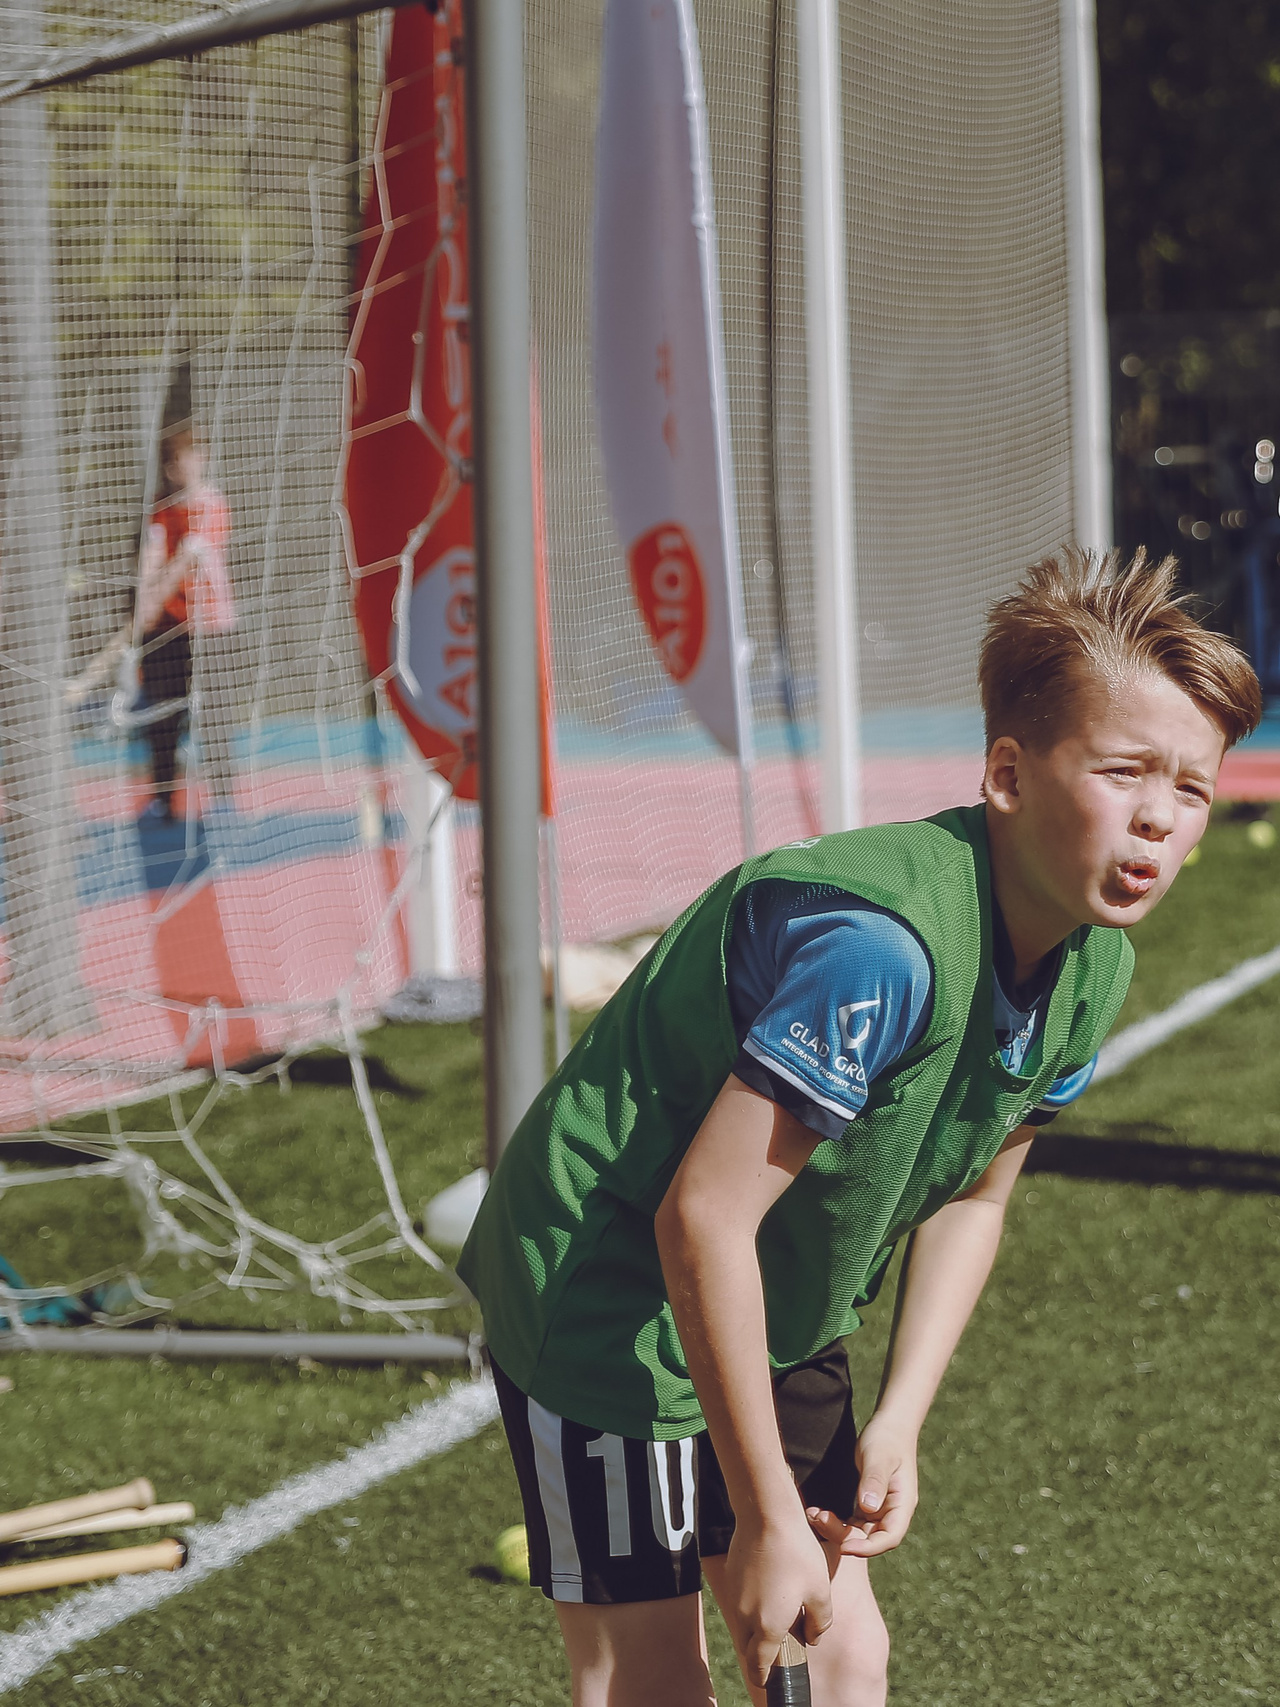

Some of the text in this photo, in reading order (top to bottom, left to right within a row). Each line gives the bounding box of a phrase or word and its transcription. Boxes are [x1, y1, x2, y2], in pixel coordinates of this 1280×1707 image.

[781, 1038, 818, 1067] INTEGRATED
[820, 1067, 850, 1087] PROPERTY
[586, 1432, 698, 1557] 10
